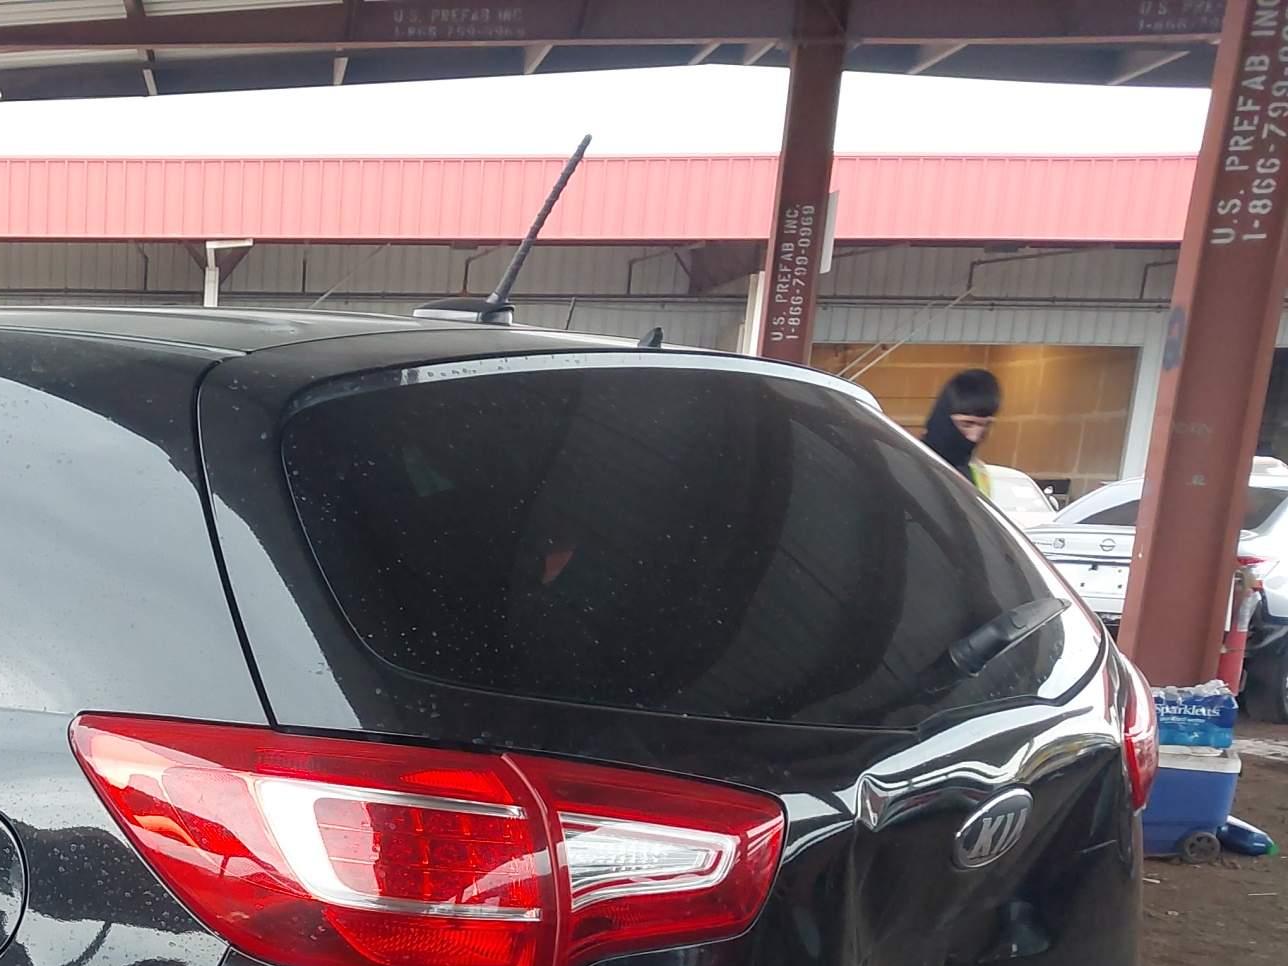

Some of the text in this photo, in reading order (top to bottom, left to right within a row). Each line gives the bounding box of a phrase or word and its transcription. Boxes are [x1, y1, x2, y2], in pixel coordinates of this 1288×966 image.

[1225, 54, 1270, 171] PREFAB
[771, 204, 801, 341] U.S. PREFAB INC.
[785, 205, 815, 339] 1-866-799-0969
[1210, 188, 1245, 244] U.S.
[966, 807, 1028, 858] KIA
